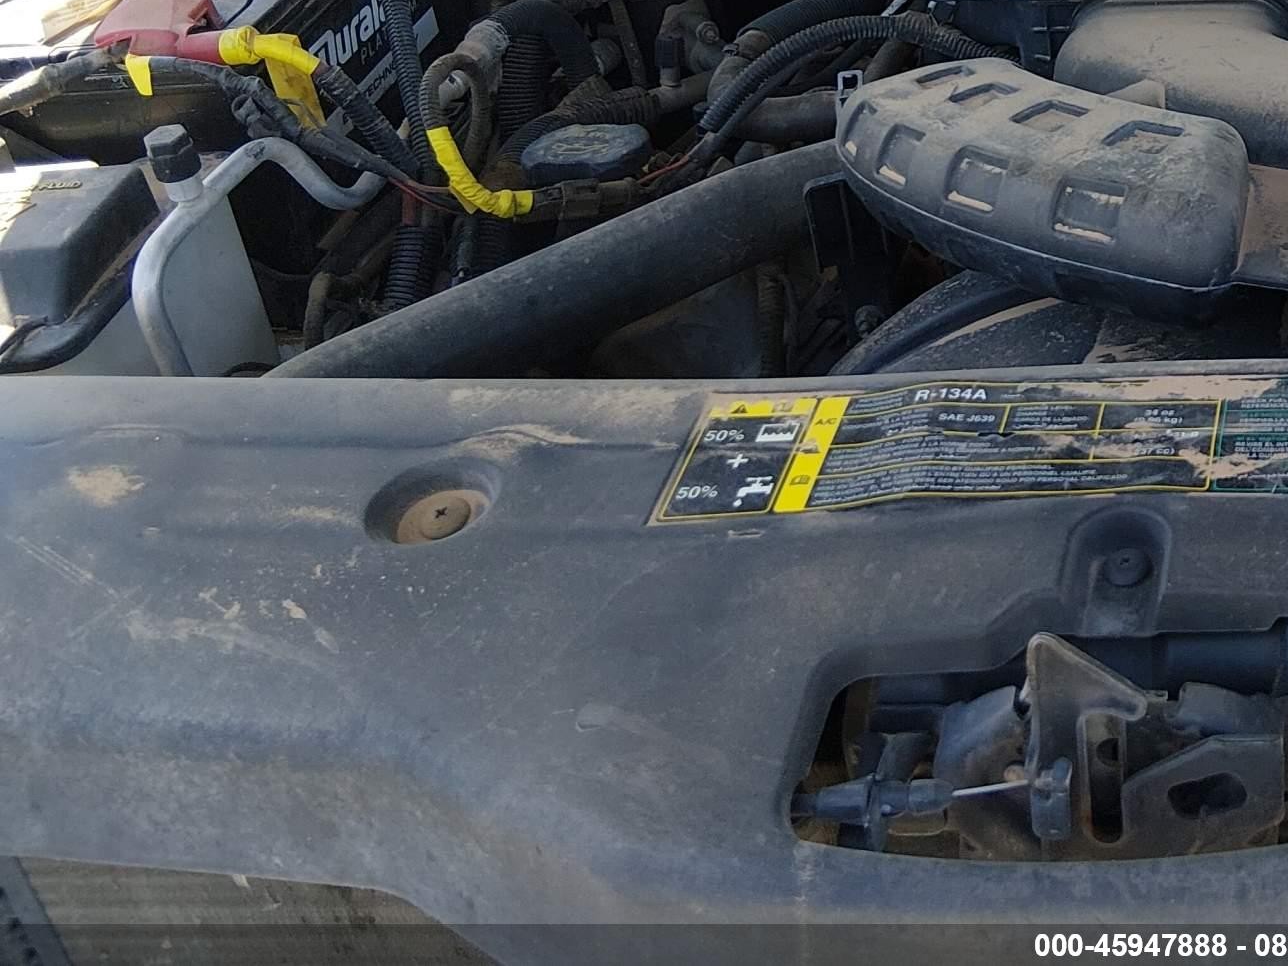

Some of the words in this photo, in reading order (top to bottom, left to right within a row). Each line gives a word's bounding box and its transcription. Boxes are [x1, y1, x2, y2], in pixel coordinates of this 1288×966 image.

[914, 387, 988, 402] R-134A
[815, 417, 837, 427] A/C
[939, 413, 966, 422] SAE
[704, 429, 745, 443] 50%
[675, 484, 719, 499] 50%
